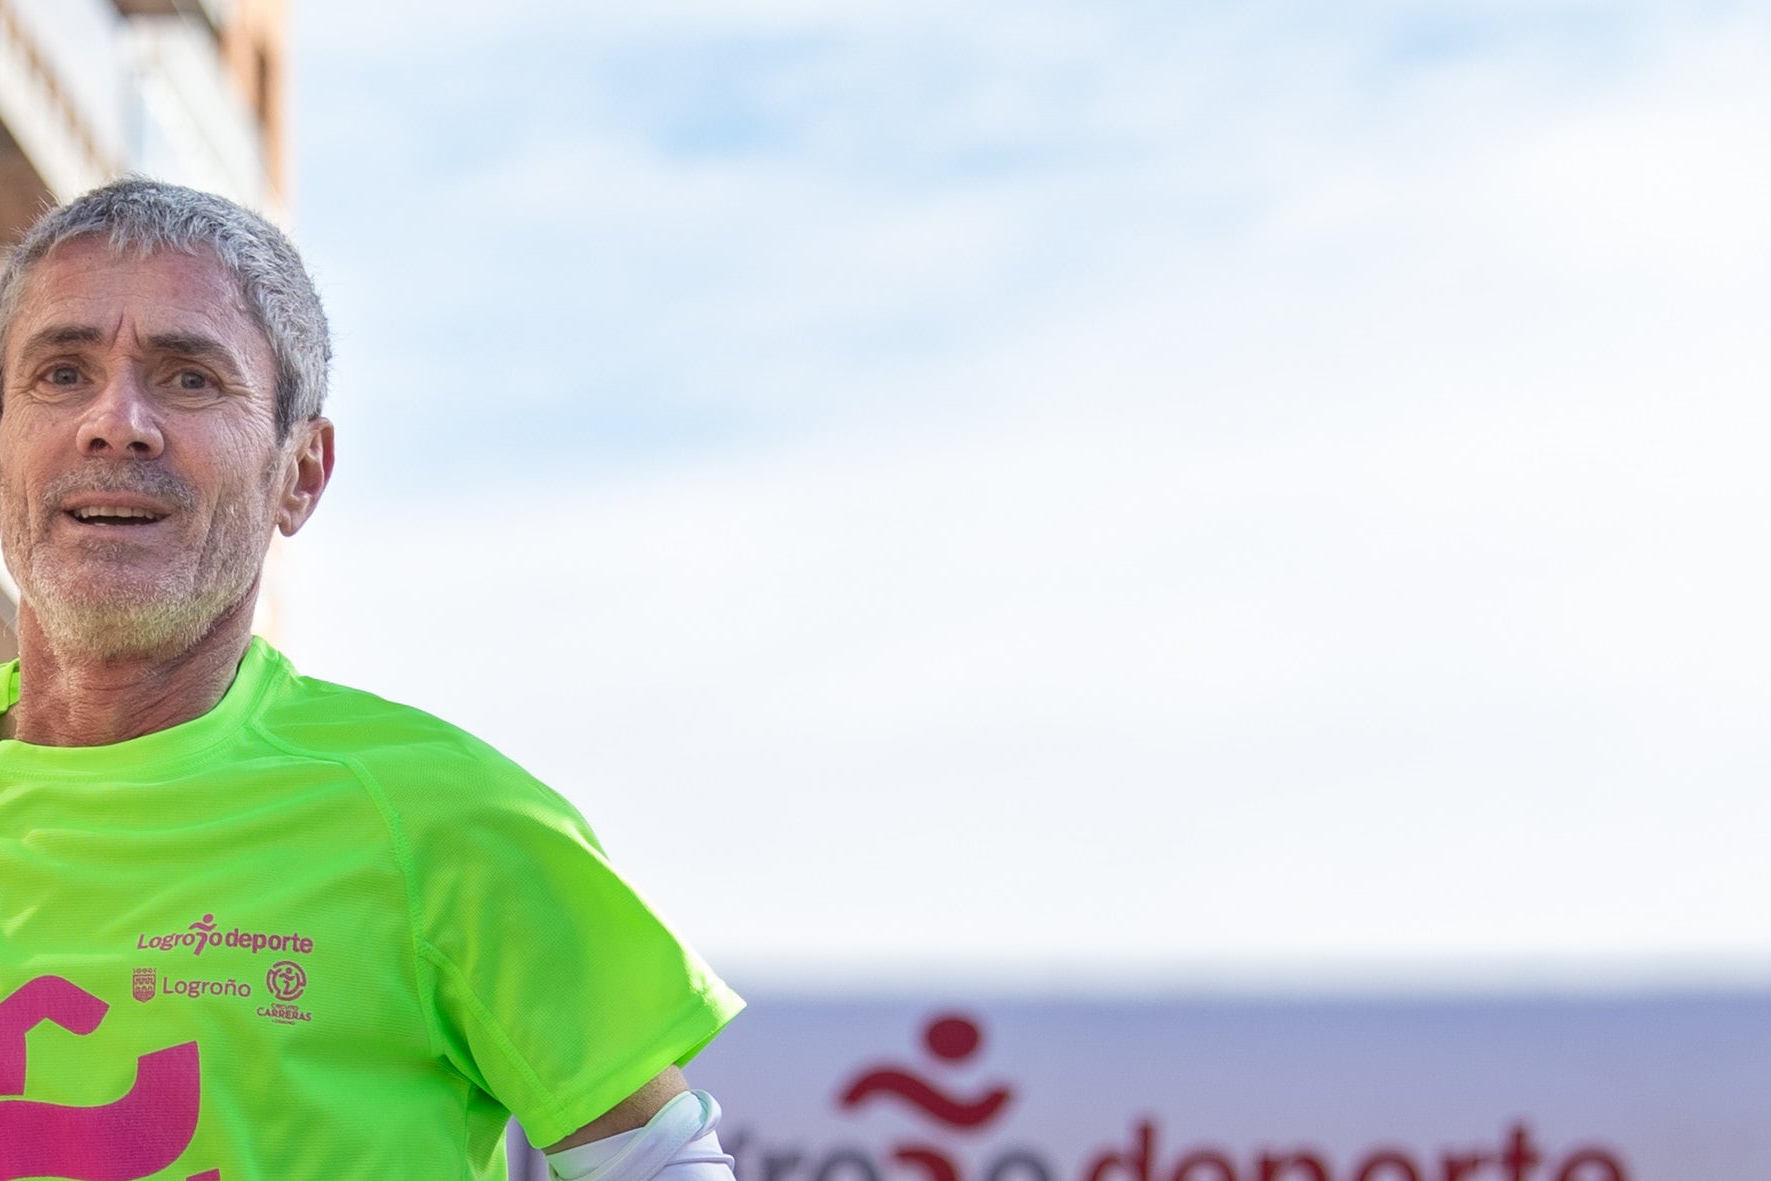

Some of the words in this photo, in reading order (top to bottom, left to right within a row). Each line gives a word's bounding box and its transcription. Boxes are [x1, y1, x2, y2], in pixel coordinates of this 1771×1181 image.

[225, 928, 314, 954] deporte
[162, 976, 251, 998] Logroño
[256, 1007, 312, 1021] CARRERAS
